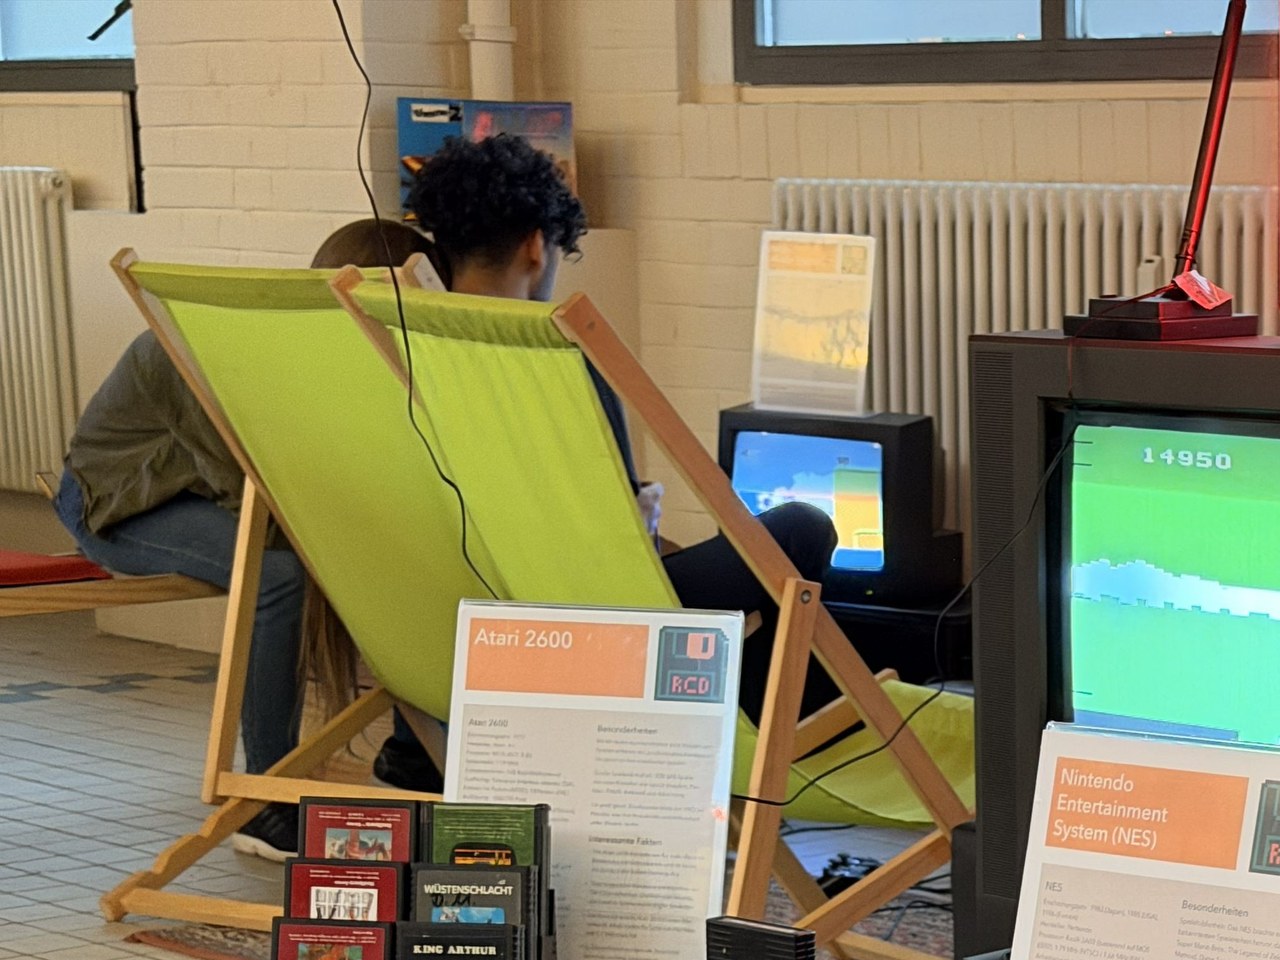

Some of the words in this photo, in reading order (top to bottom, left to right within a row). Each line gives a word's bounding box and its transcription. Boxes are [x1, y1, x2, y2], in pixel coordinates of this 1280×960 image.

[1142, 447, 1231, 470] 14950
[474, 628, 519, 647] Atari
[525, 630, 573, 649] 2600
[671, 676, 709, 695] RCD
[1060, 768, 1134, 793] Nintendo
[1056, 794, 1169, 823] Entertainment
[1052, 819, 1108, 843] System
[1111, 825, 1158, 851] (NES)
[424, 883, 513, 896] WÜSTENSCHLACHT
[1045, 881, 1062, 891] NES
[1181, 900, 1249, 917] Besonderheiten
[413, 945, 443, 955] KING
[447, 945, 497, 956] ARTHUR
